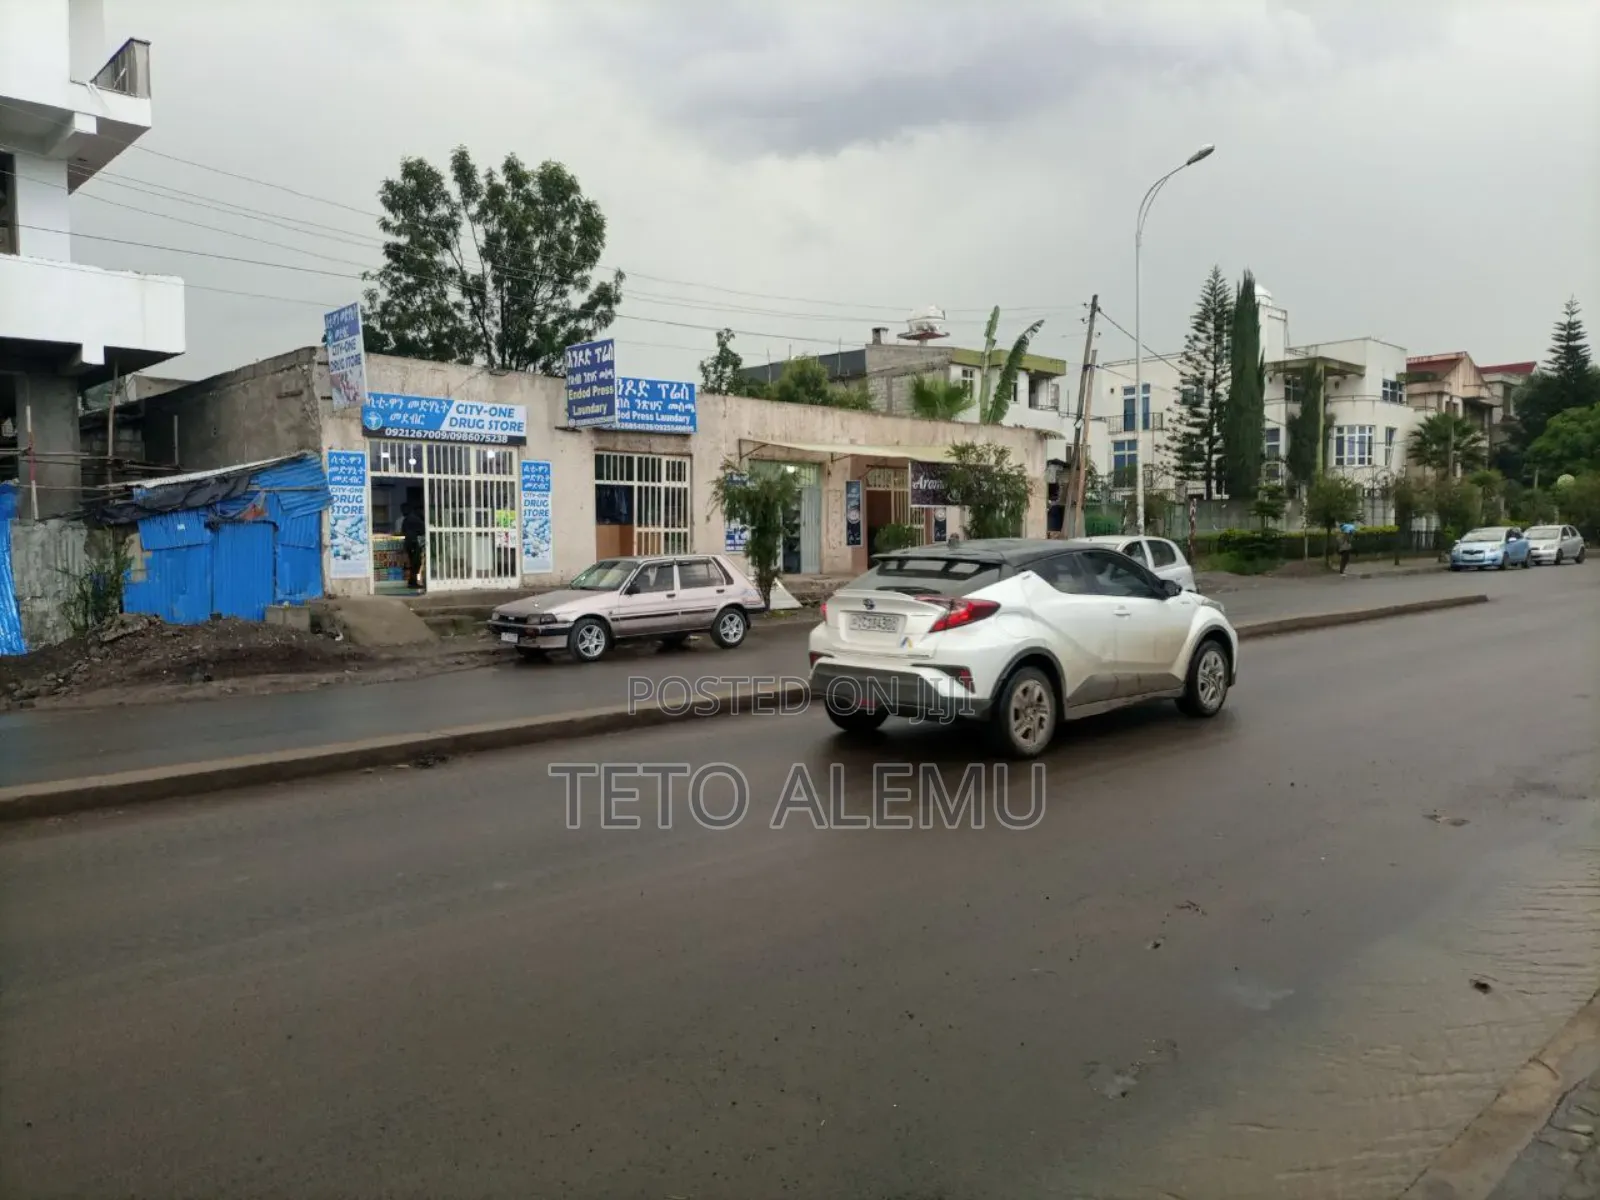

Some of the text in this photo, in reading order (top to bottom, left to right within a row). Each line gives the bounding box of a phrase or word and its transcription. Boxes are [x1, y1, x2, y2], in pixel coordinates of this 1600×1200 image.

[456, 403, 515, 419] CITY-ONE
[631, 411, 654, 421] Press
[449, 416, 525, 432] DRUG STORE
[330, 494, 363, 504] DRUG
[523, 499, 549, 507] DRUG
[330, 505, 365, 515] STORE
[523, 509, 550, 517] STORE
